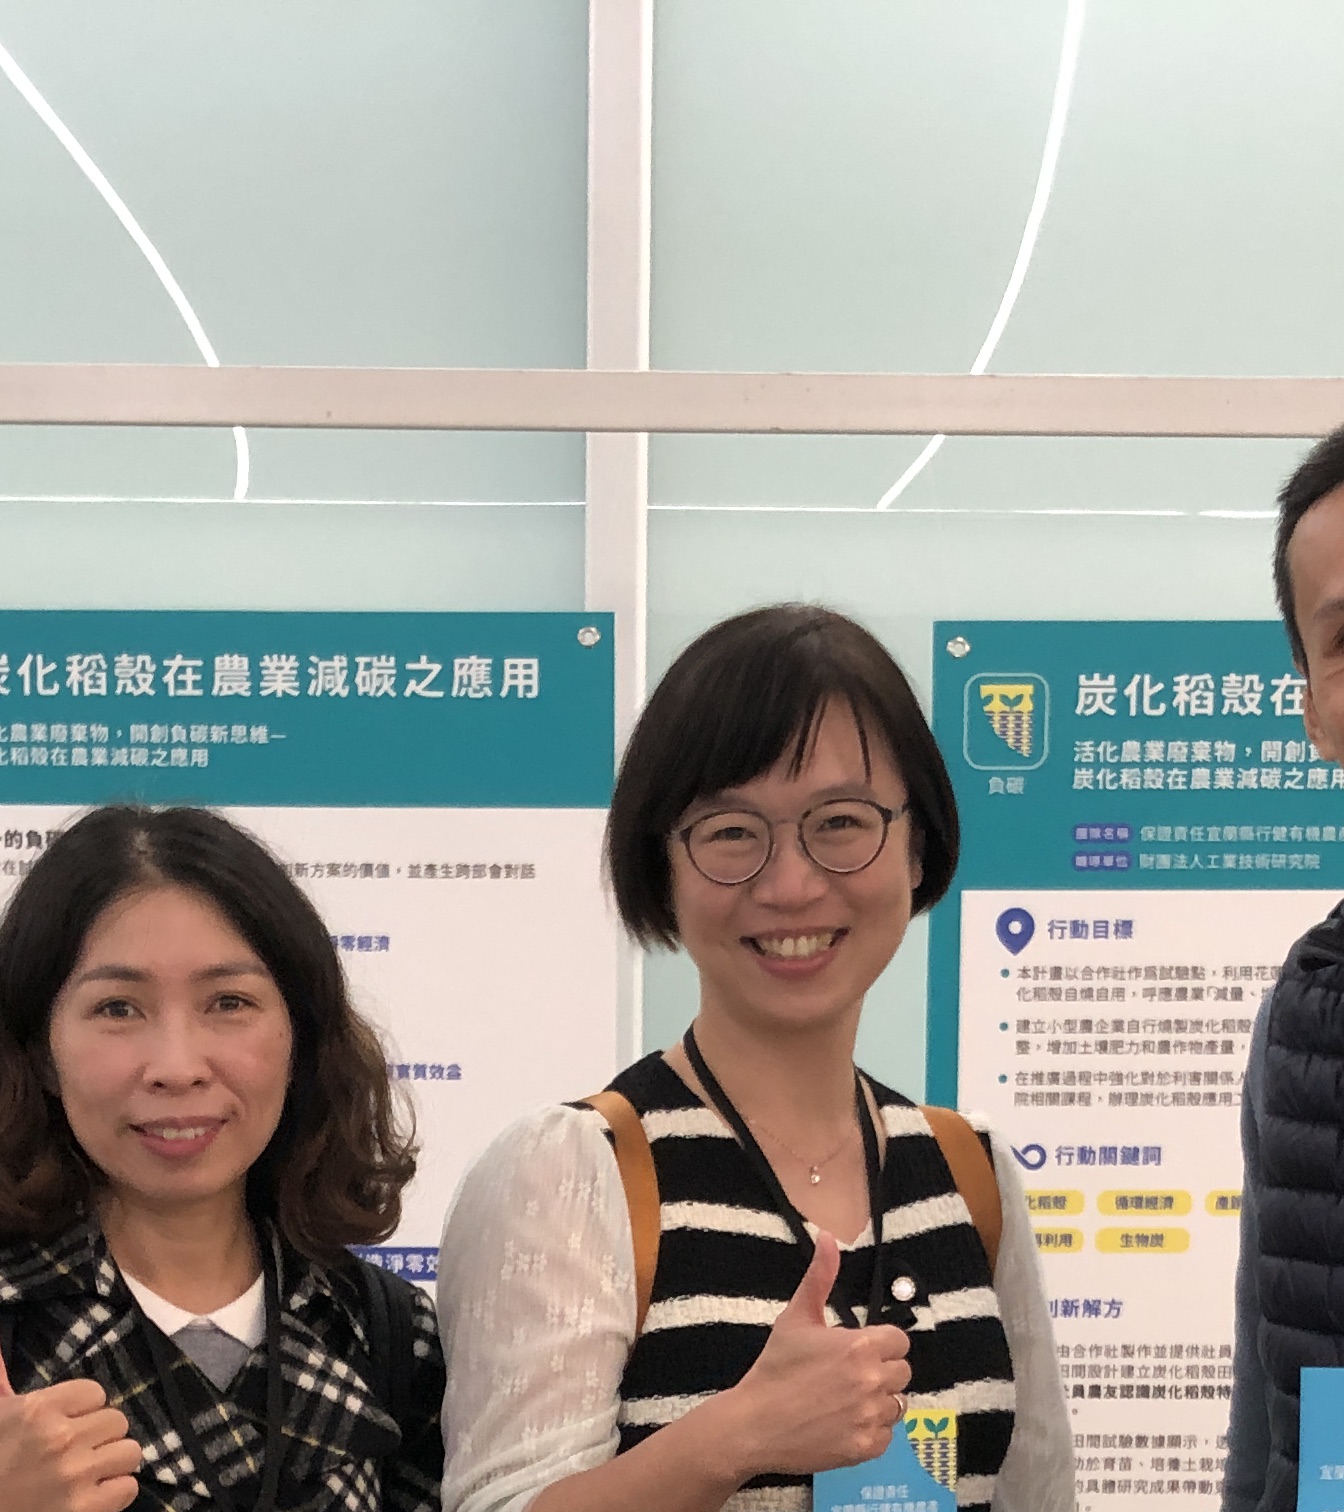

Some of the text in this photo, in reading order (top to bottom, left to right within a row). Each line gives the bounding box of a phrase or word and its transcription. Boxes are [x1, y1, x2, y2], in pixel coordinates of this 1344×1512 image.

[1075, 674, 1306, 717] 炭化稻殼在
[988, 778, 1023, 795] 負碳
[1047, 919, 1134, 939] 行動目標
[1055, 1146, 1162, 1166] 行動關鍵詞
[1115, 1196, 1174, 1210] 循環經濟
[1120, 1234, 1164, 1248] 生物炭
